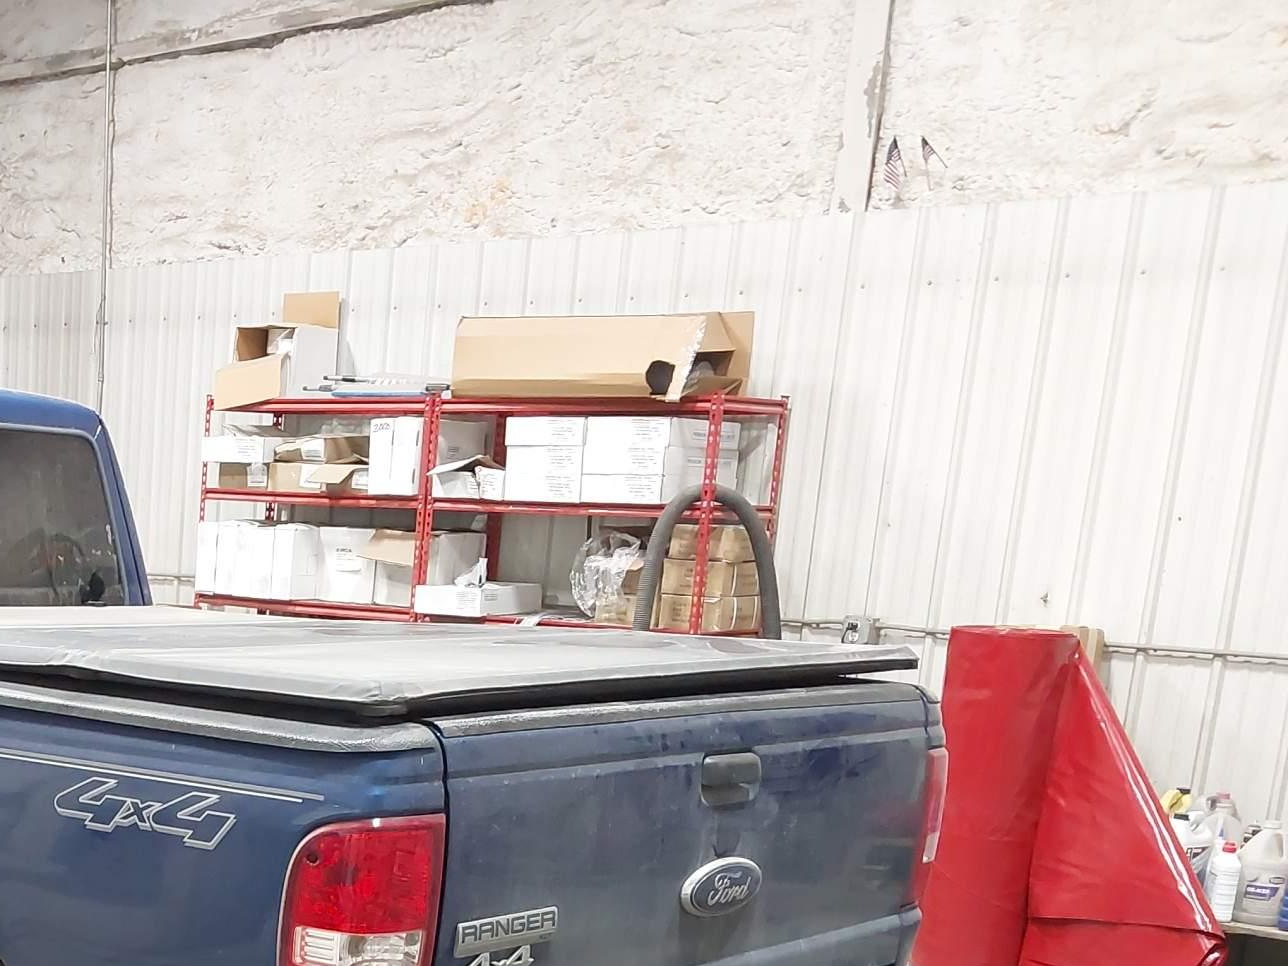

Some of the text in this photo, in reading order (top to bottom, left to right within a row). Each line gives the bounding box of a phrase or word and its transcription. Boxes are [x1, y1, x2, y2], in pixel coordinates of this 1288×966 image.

[54, 776, 237, 850] 4x4
[707, 871, 752, 906] Ford
[461, 910, 556, 944] RANGER
